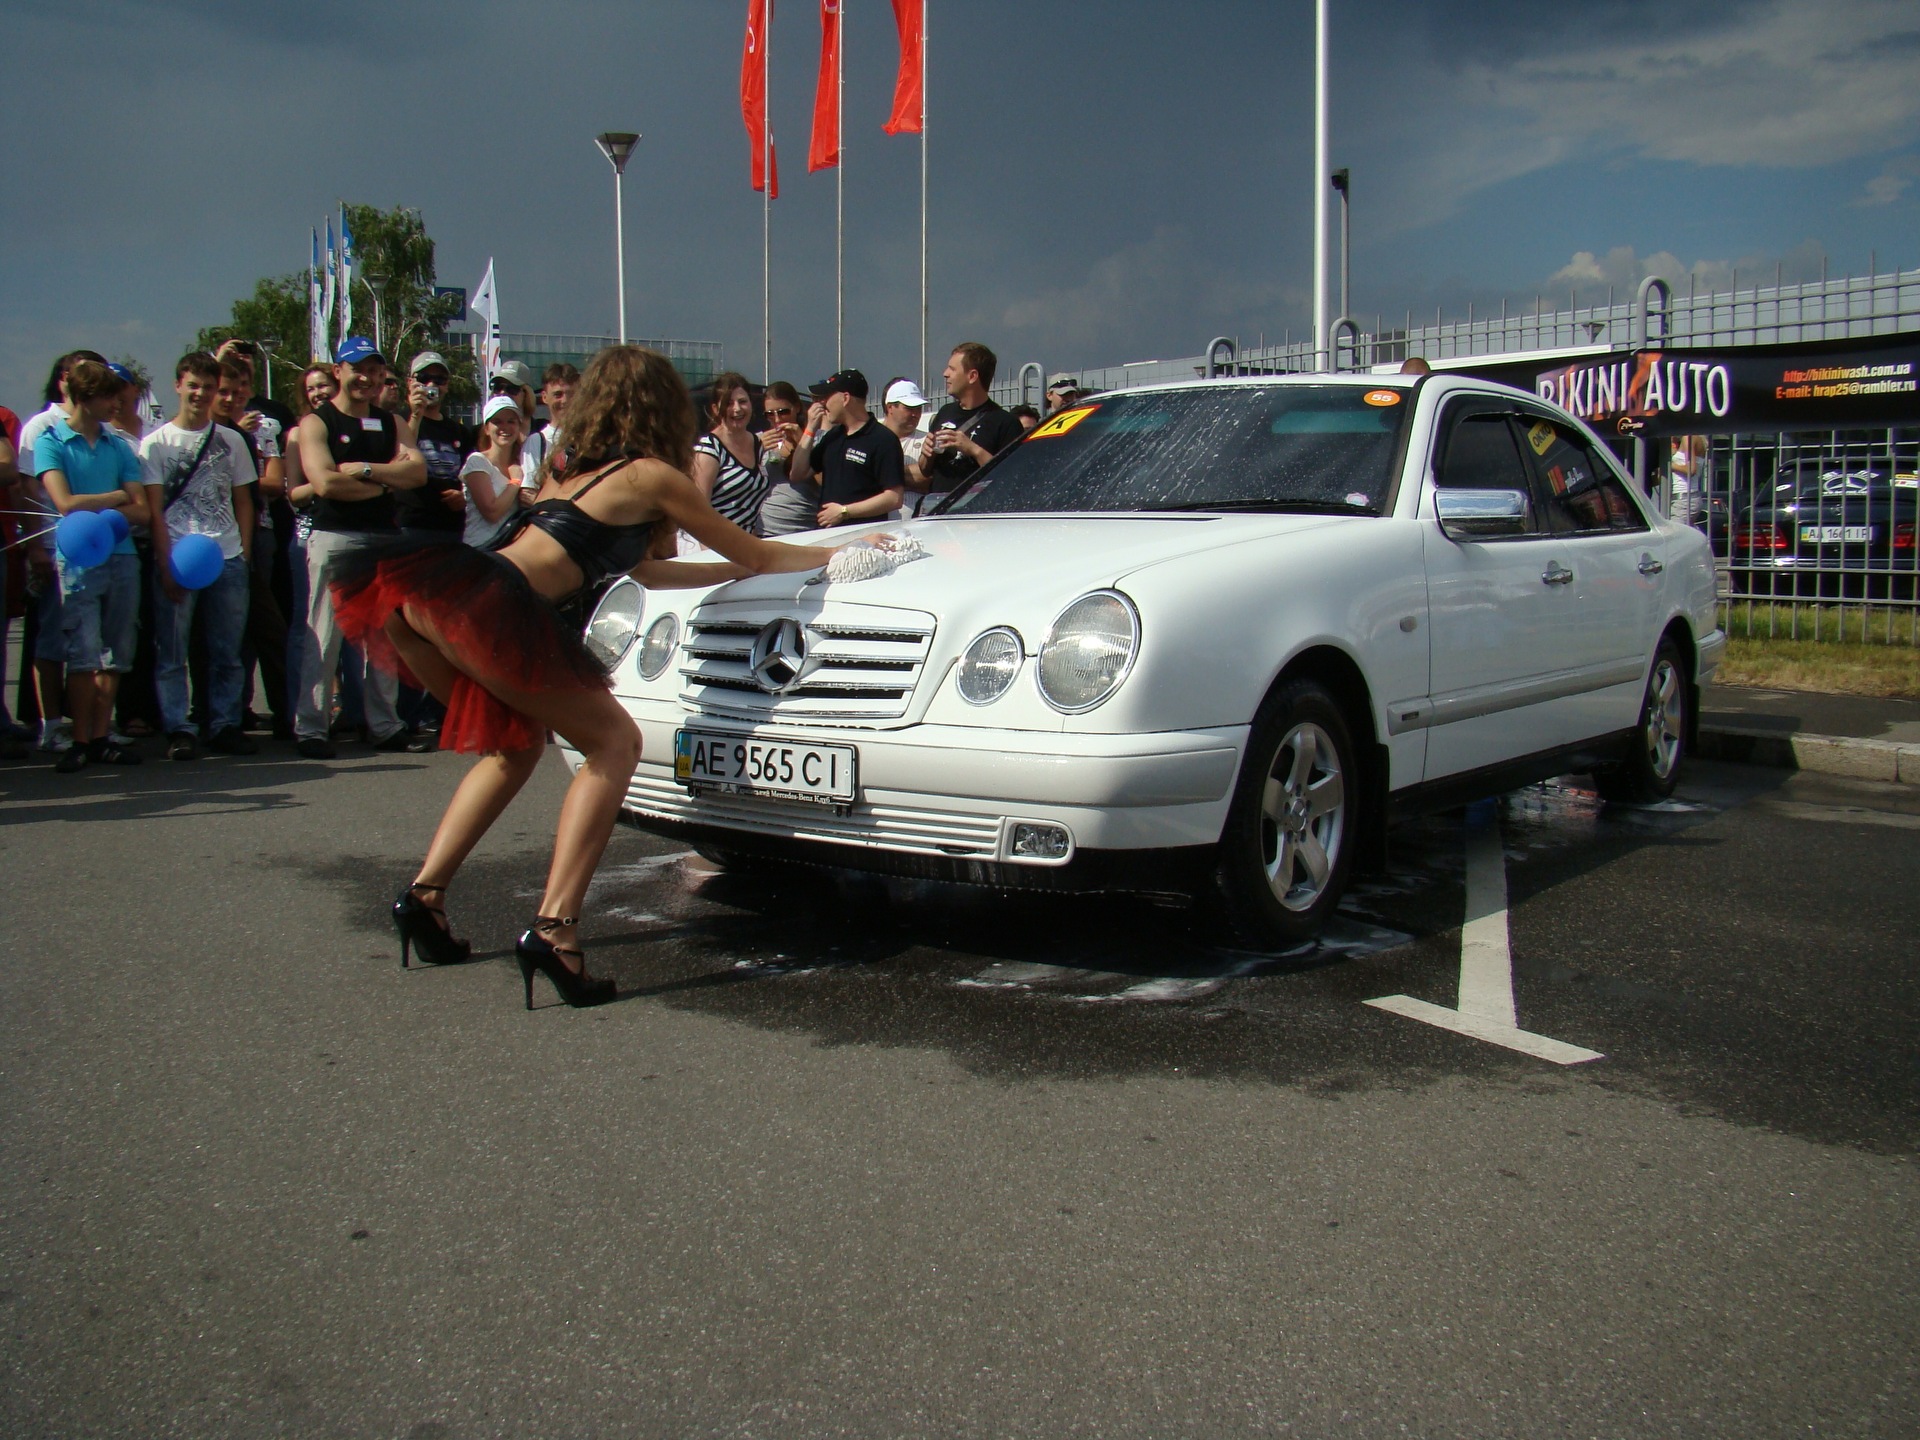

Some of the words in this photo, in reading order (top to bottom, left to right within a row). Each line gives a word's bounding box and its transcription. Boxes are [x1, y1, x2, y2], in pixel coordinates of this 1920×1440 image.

[1783, 363, 1910, 382] http://bikiniwash.com.ua
[1644, 361, 1730, 417] AUTO
[1776, 386, 1811, 399] E-mail:
[1813, 380, 1916, 397] hrap25@rambler.ru
[680, 762, 690, 772] UA
[692, 741, 726, 776] AE
[734, 744, 794, 783] 9565
[802, 751, 836, 788] CI
